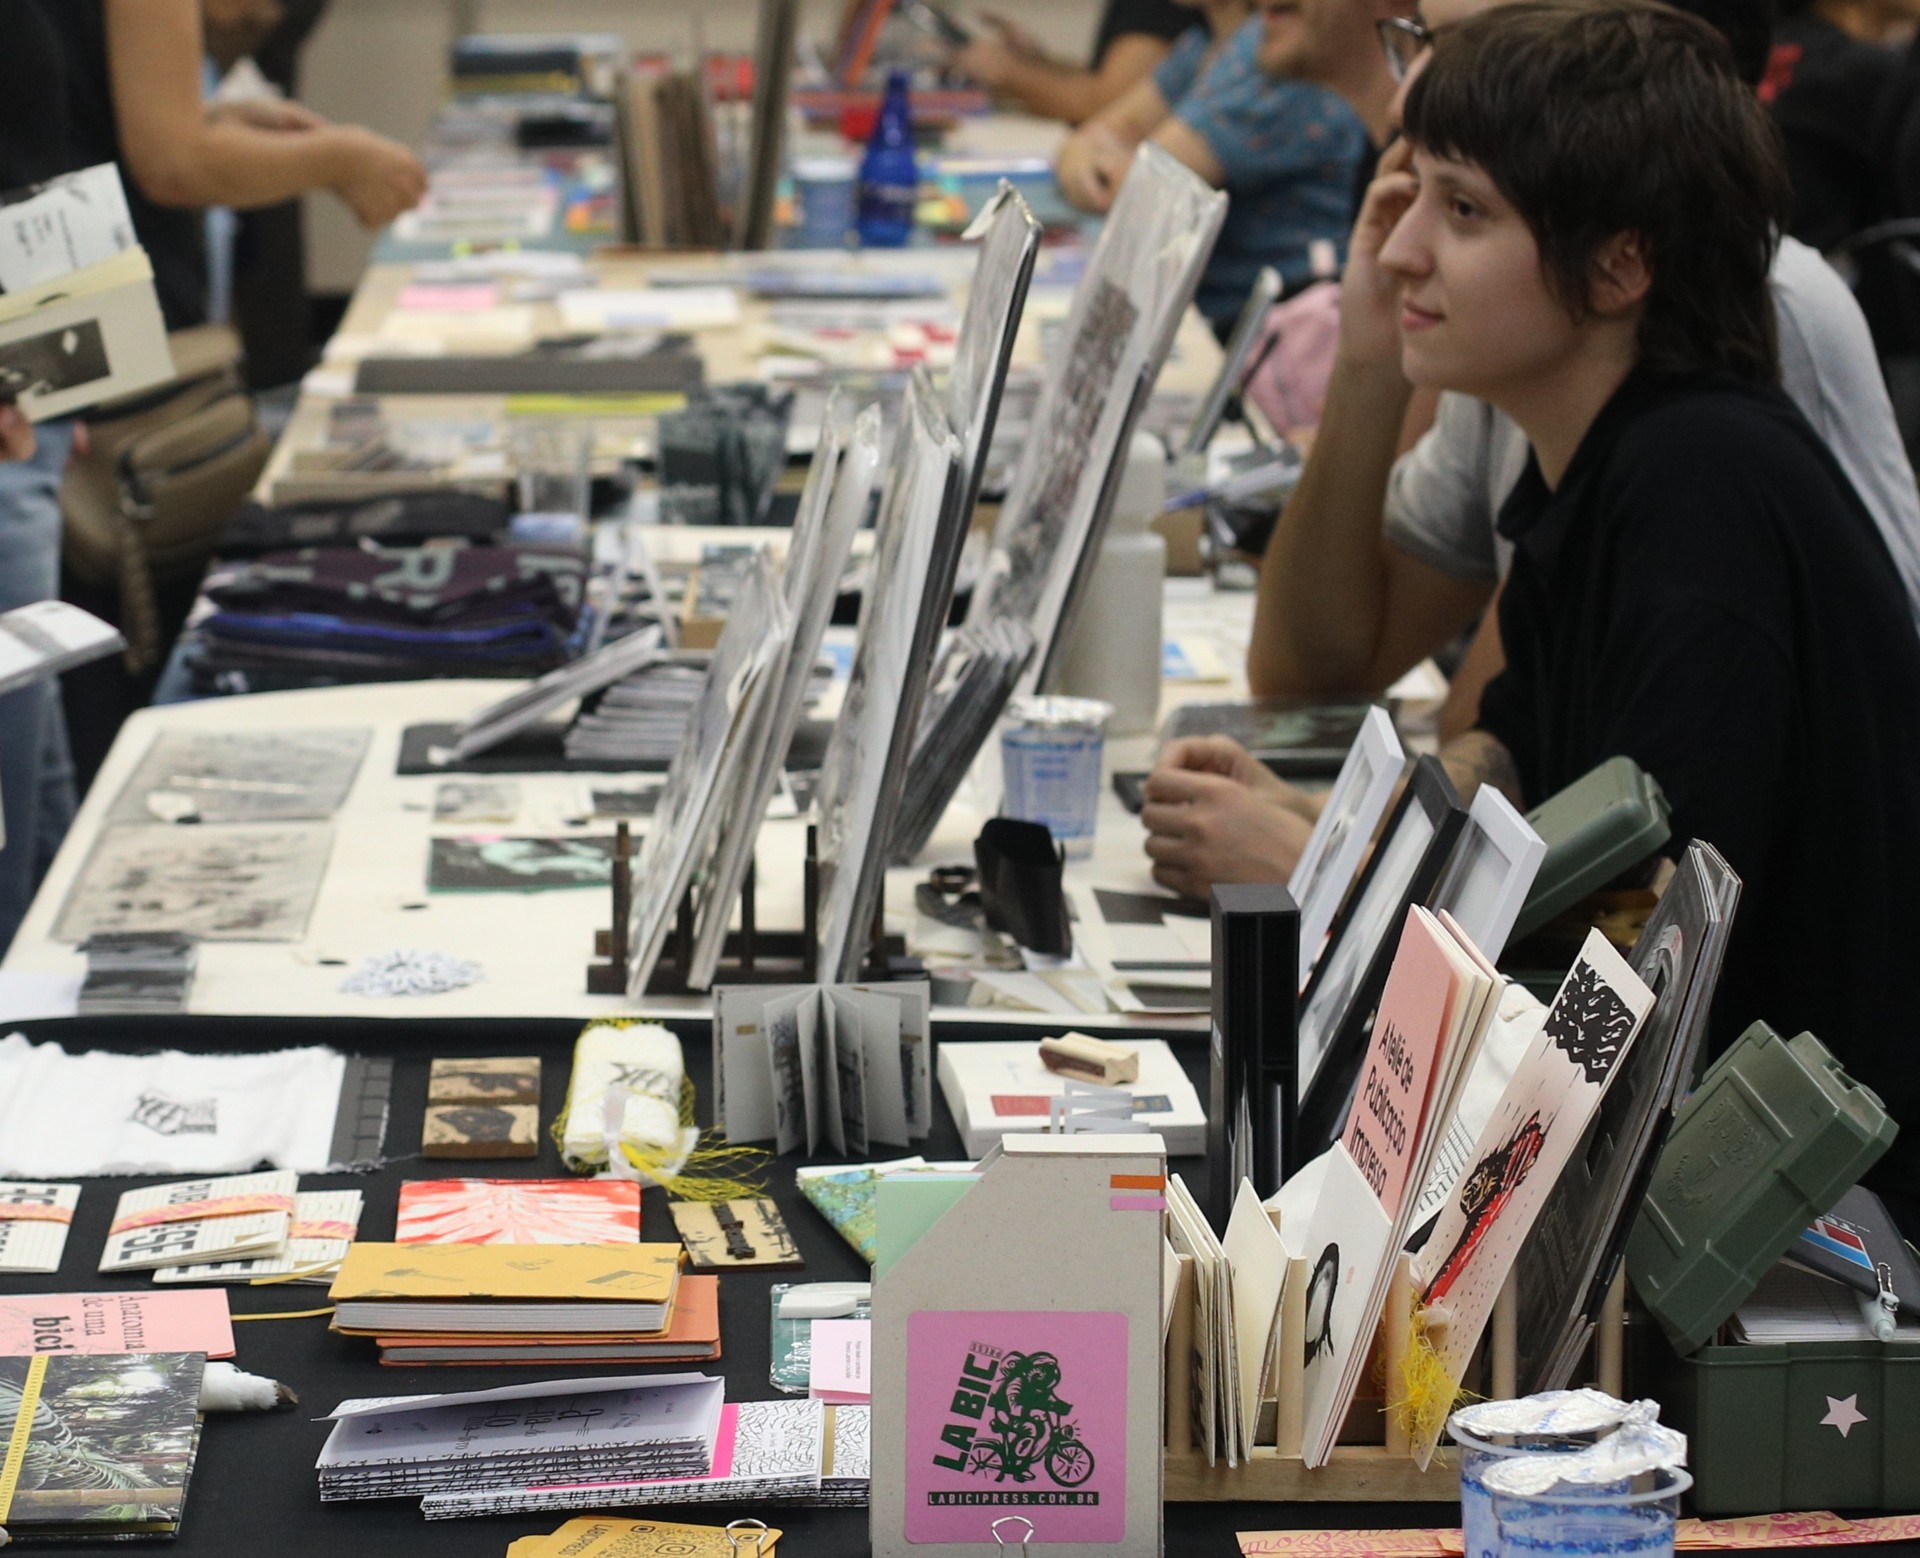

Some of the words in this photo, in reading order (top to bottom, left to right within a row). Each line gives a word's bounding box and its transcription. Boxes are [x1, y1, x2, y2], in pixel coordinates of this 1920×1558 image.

[1400, 1052, 1414, 1094] de
[1363, 1064, 1407, 1157] Publicação
[82, 1297, 114, 1307] de
[32, 1315, 75, 1352] bici
[932, 1424, 977, 1473] LA
[928, 1492, 1096, 1505] LABICIPRESS.COM.BR
